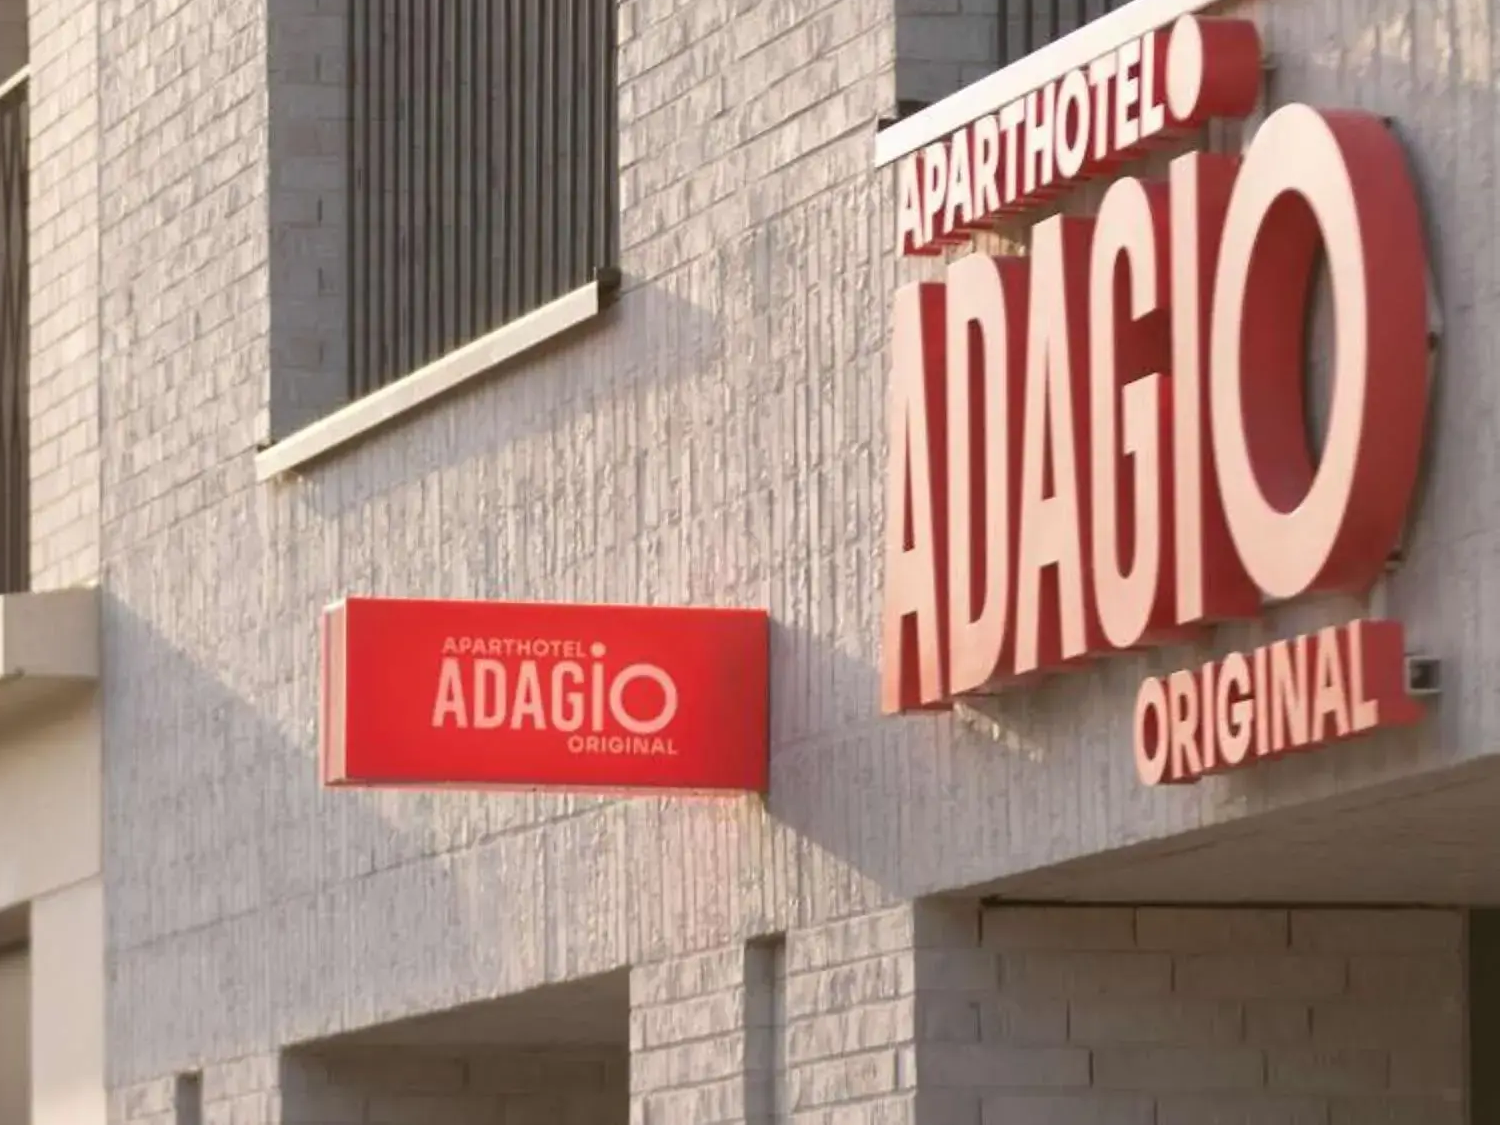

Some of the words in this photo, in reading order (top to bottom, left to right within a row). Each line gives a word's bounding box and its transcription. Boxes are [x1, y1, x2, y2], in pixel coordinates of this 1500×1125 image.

[898, 29, 1167, 248] APARTHOTEL
[442, 636, 587, 658] APARTHOTEL
[567, 735, 678, 755] ORIGINAL
[1132, 620, 1379, 787] ORIGINAL
